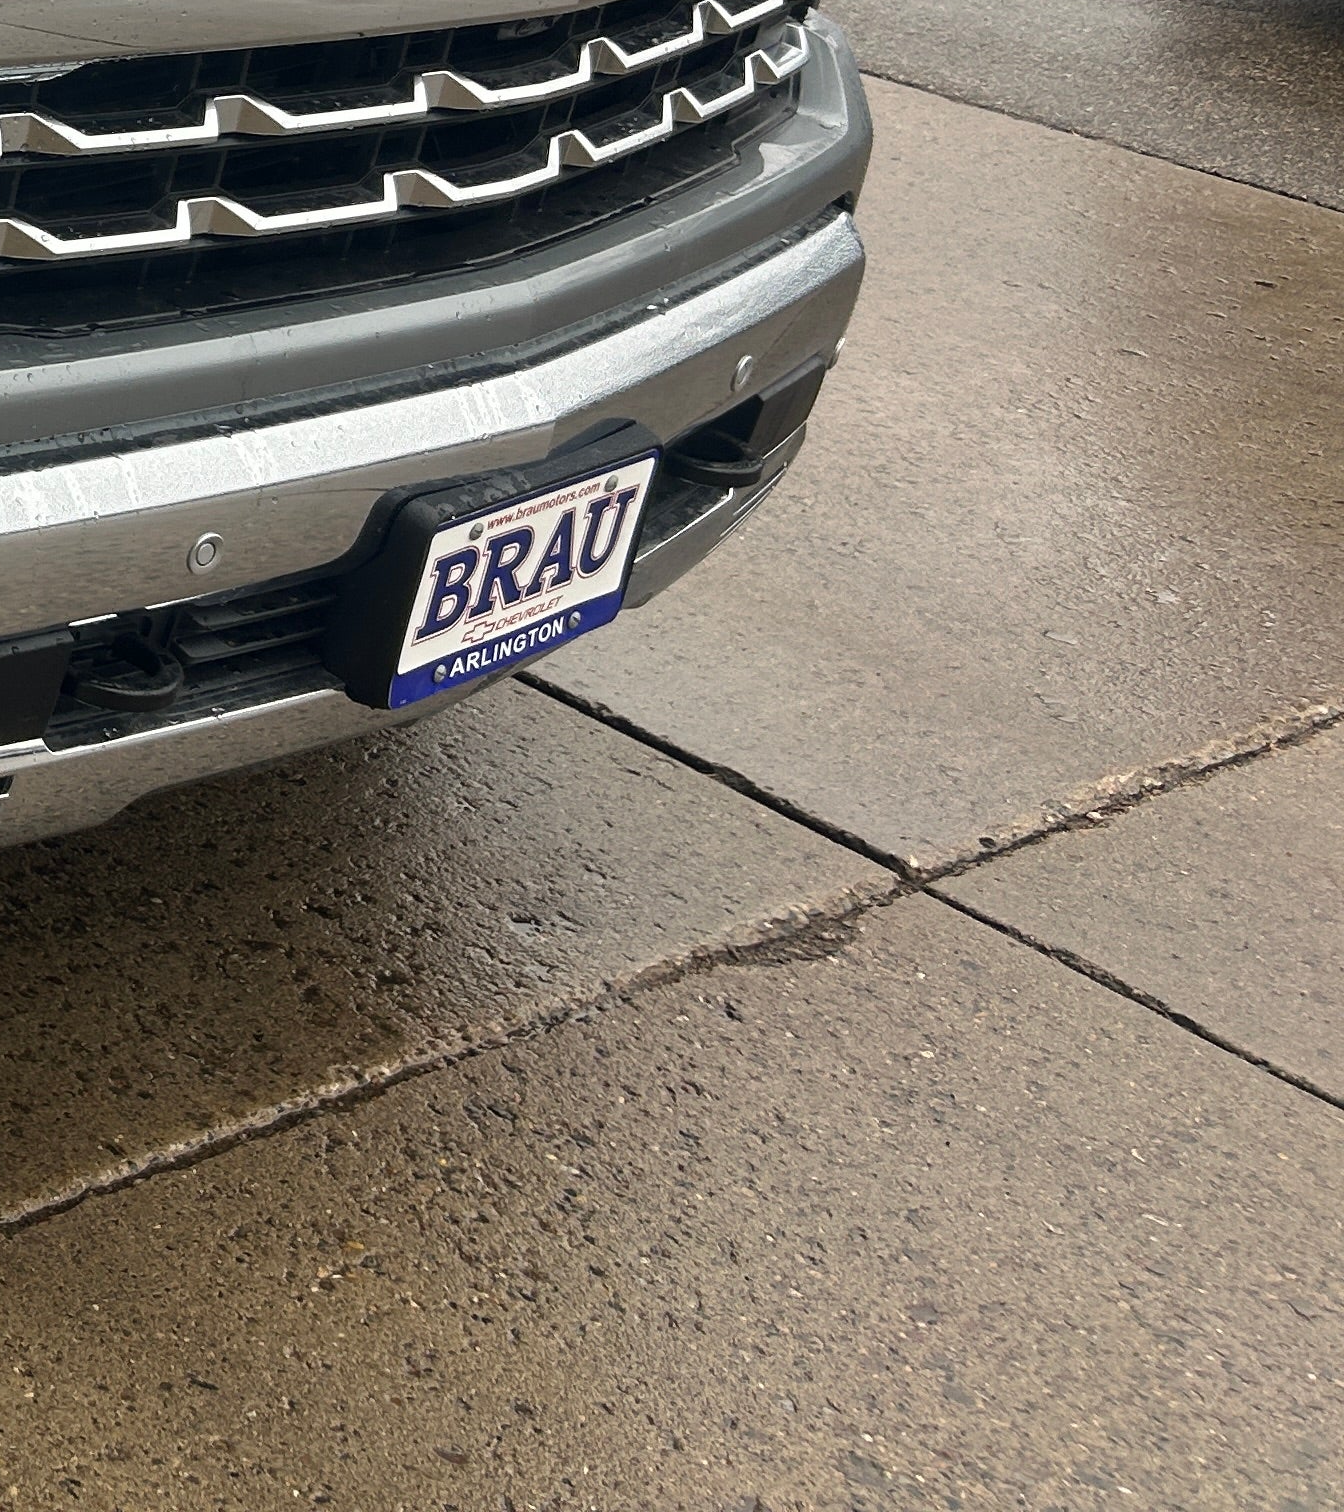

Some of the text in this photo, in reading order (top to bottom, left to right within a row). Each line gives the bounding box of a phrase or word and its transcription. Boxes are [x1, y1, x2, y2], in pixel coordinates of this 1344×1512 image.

[486, 481, 601, 531] www.braumotors.com
[410, 483, 641, 647] BRAU
[495, 595, 564, 631] CHEVROLET
[449, 616, 565, 678] ARLINGTON
